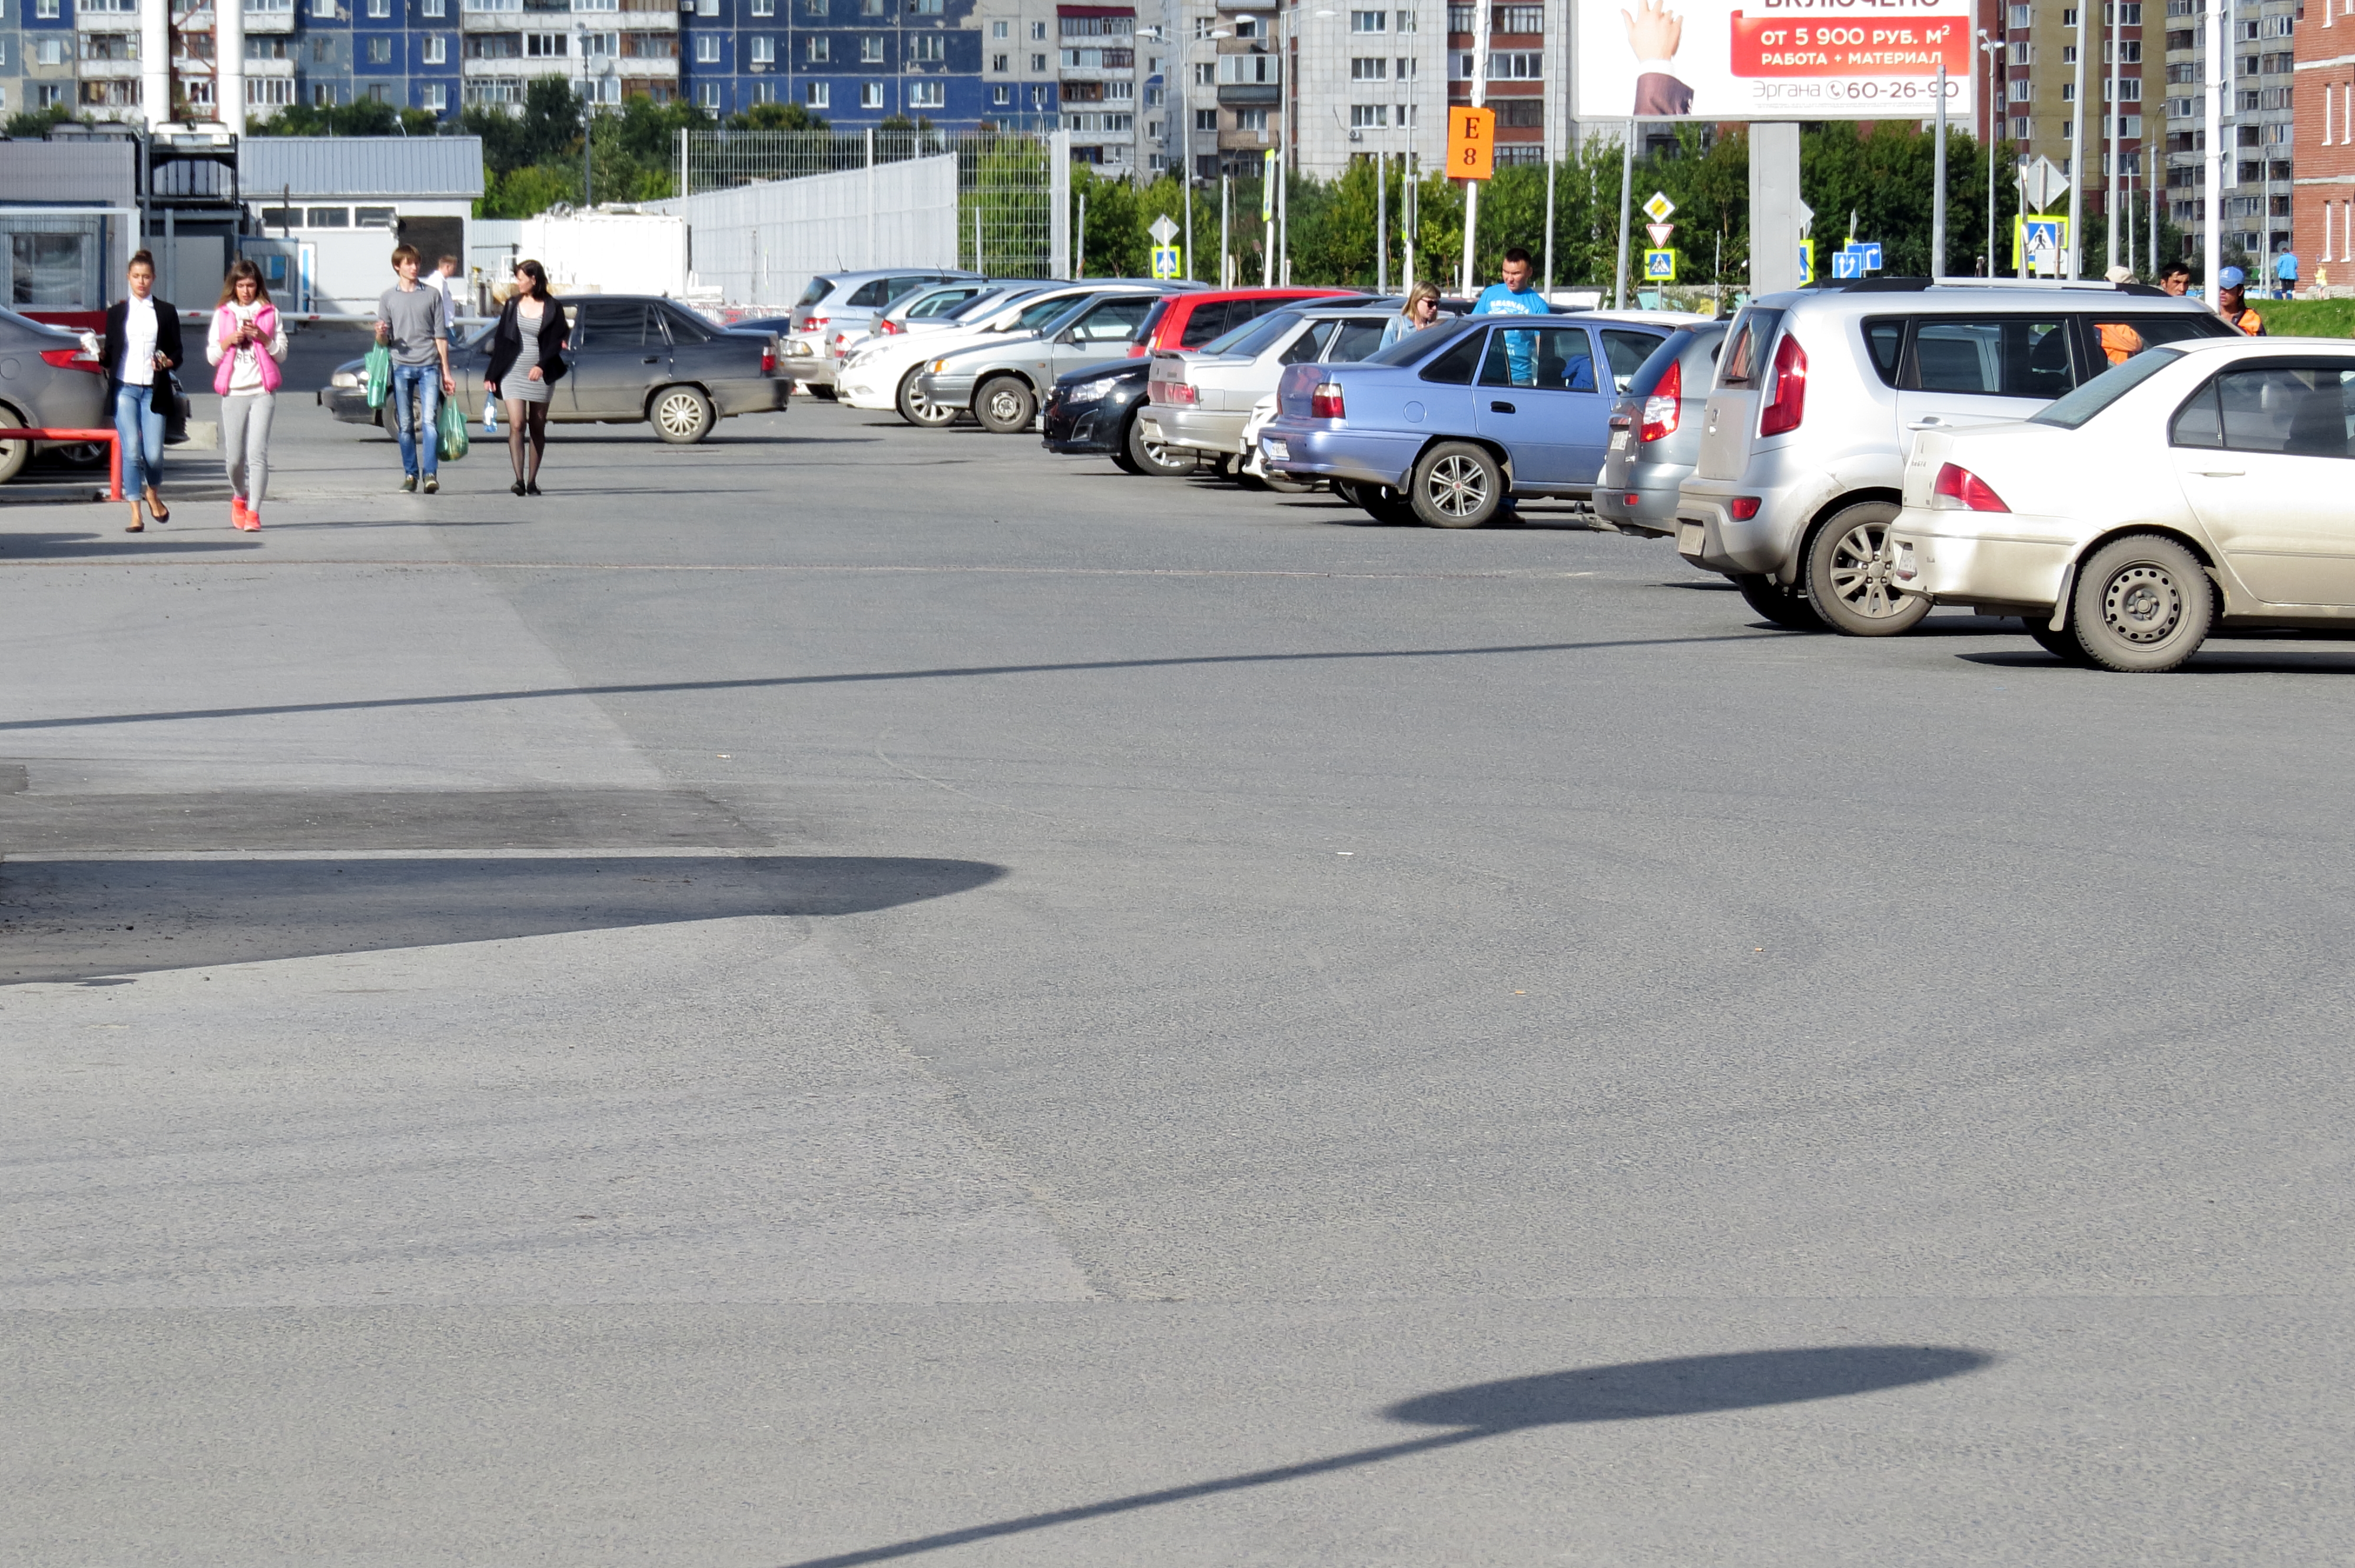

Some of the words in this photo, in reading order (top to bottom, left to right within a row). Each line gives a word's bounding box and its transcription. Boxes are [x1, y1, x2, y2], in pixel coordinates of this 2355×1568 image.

[1760, 31, 1787, 45] ОТ
[1795, 28, 1809, 45] 5
[1816, 28, 1865, 45] 900
[1873, 30, 1918, 45] РУБ.
[1762, 53, 1827, 65] РАБОТА
[1849, 52, 1942, 65] МАТЕРИАЛ
[1753, 80, 1820, 101] Эргана
[1847, 81, 1959, 99] 60-26-90
[1464, 148, 1477, 165] 8
